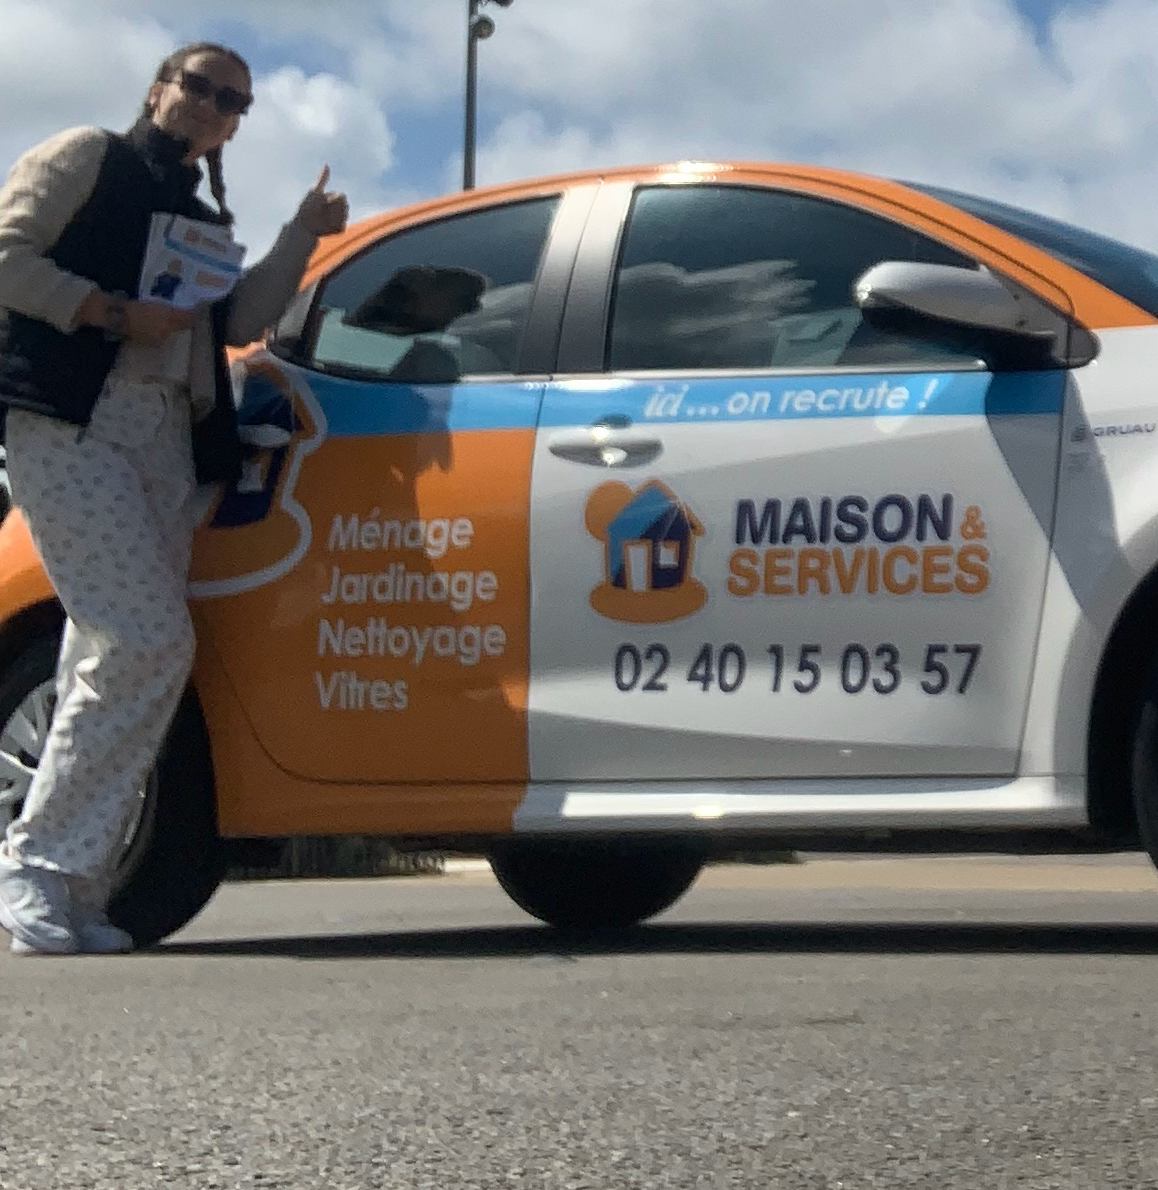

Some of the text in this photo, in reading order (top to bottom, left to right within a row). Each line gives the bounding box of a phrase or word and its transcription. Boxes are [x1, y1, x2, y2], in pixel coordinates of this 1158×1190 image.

[727, 390, 772, 416] on
[780, 380, 910, 413] recrute
[1093, 422, 1157, 438] GRUAU
[327, 507, 475, 559] Ménage
[735, 493, 953, 545] MAISON
[320, 562, 499, 611] Jardinage
[727, 544, 990, 596] SERVICES
[318, 616, 508, 668] Nettoyage
[315, 671, 409, 710] Vitres
[614, 642, 982, 695] 02 40 15 03 57
